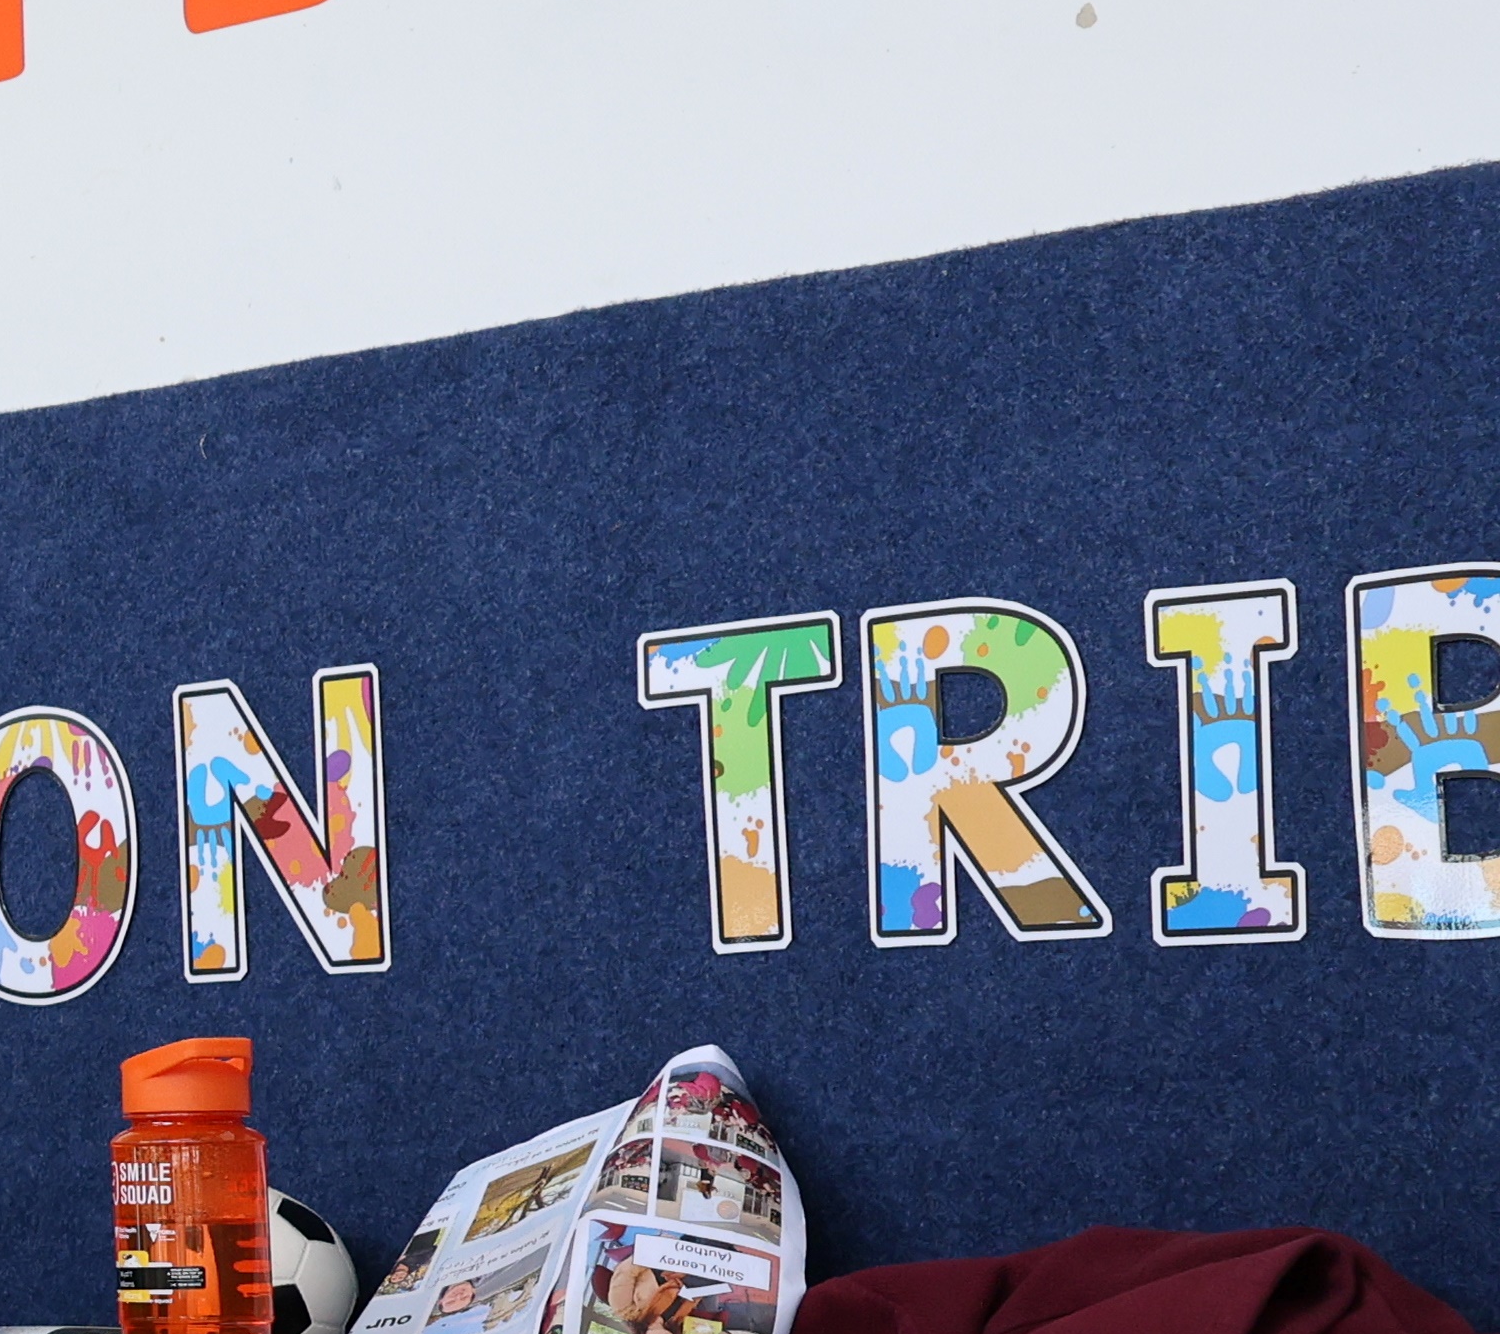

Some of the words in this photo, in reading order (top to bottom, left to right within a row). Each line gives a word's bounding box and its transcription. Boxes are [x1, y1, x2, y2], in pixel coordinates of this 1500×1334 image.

[120, 1162, 171, 1181] SMILE
[120, 1186, 172, 1205] SQUAD
[674, 1242, 732, 1263] (Author)
[659, 1255, 707, 1274] Learey
[710, 1265, 745, 1281] Sally
[366, 1314, 412, 1331] our
